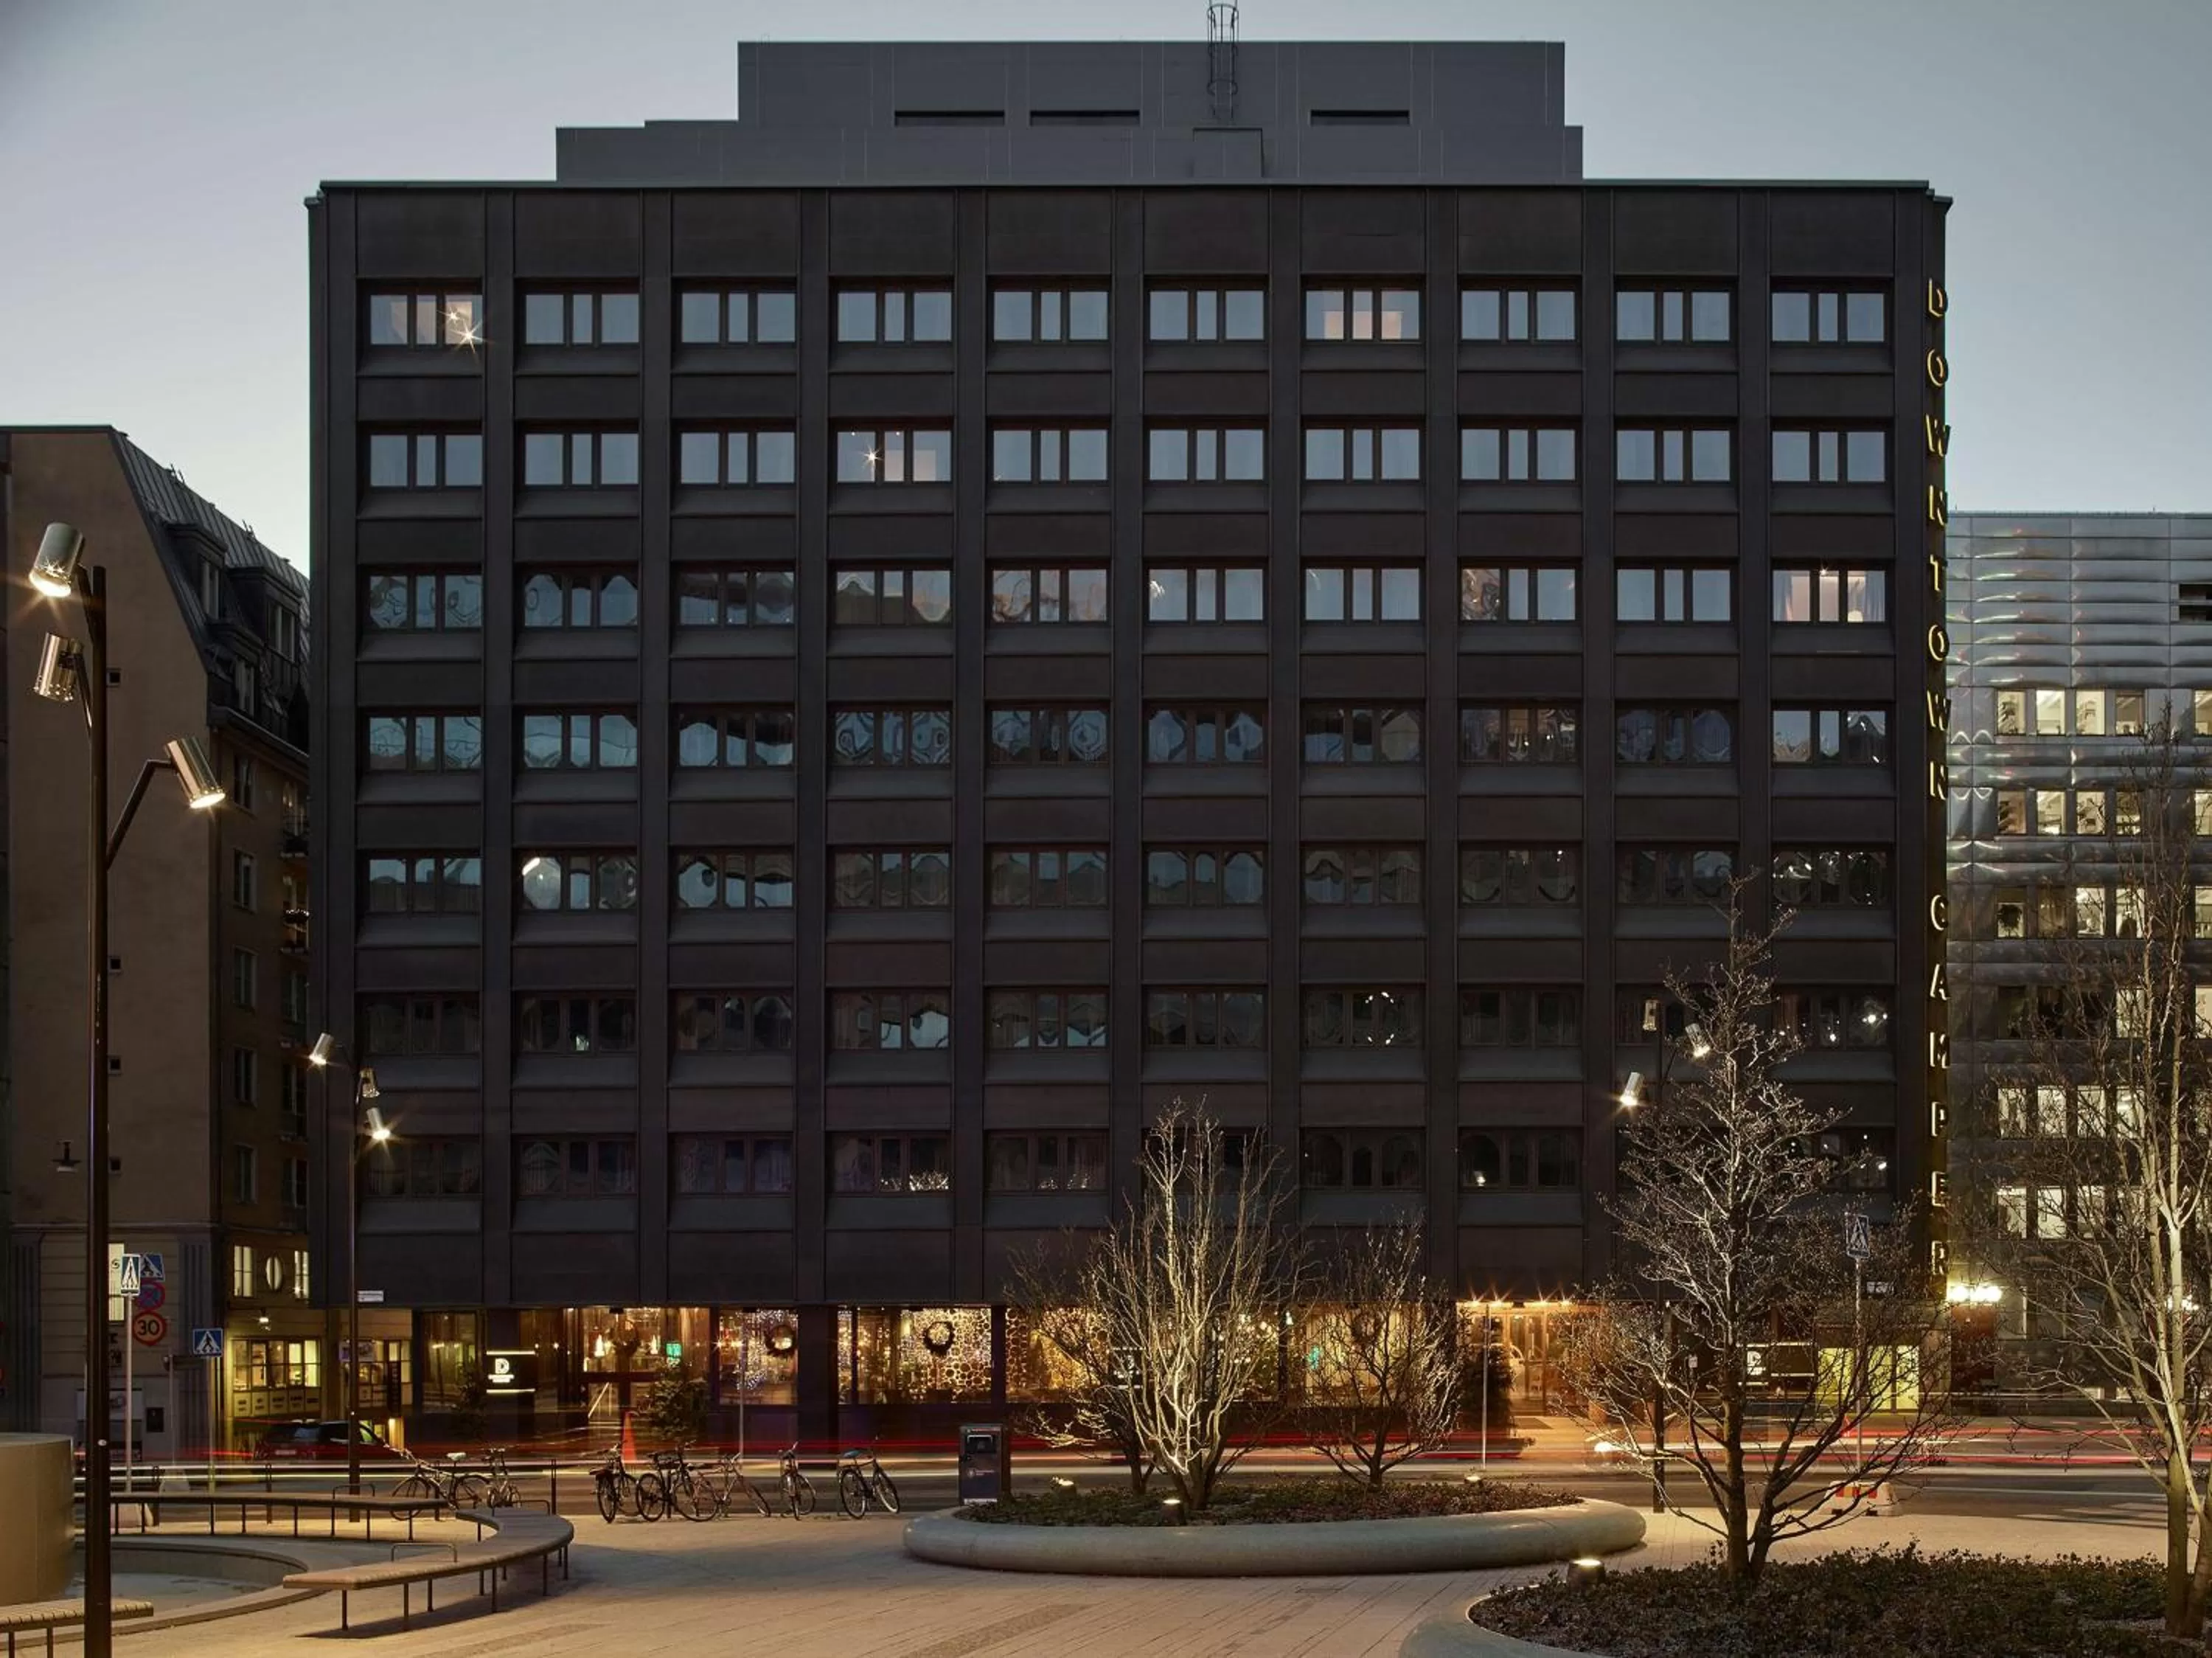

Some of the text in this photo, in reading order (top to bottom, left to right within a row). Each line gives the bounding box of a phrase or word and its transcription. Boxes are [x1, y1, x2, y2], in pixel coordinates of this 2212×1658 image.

[1925, 277, 1950, 1276] DOWNTOWN CAMPER
[137, 1319, 159, 1336] 30
[495, 1358, 509, 1374] D
